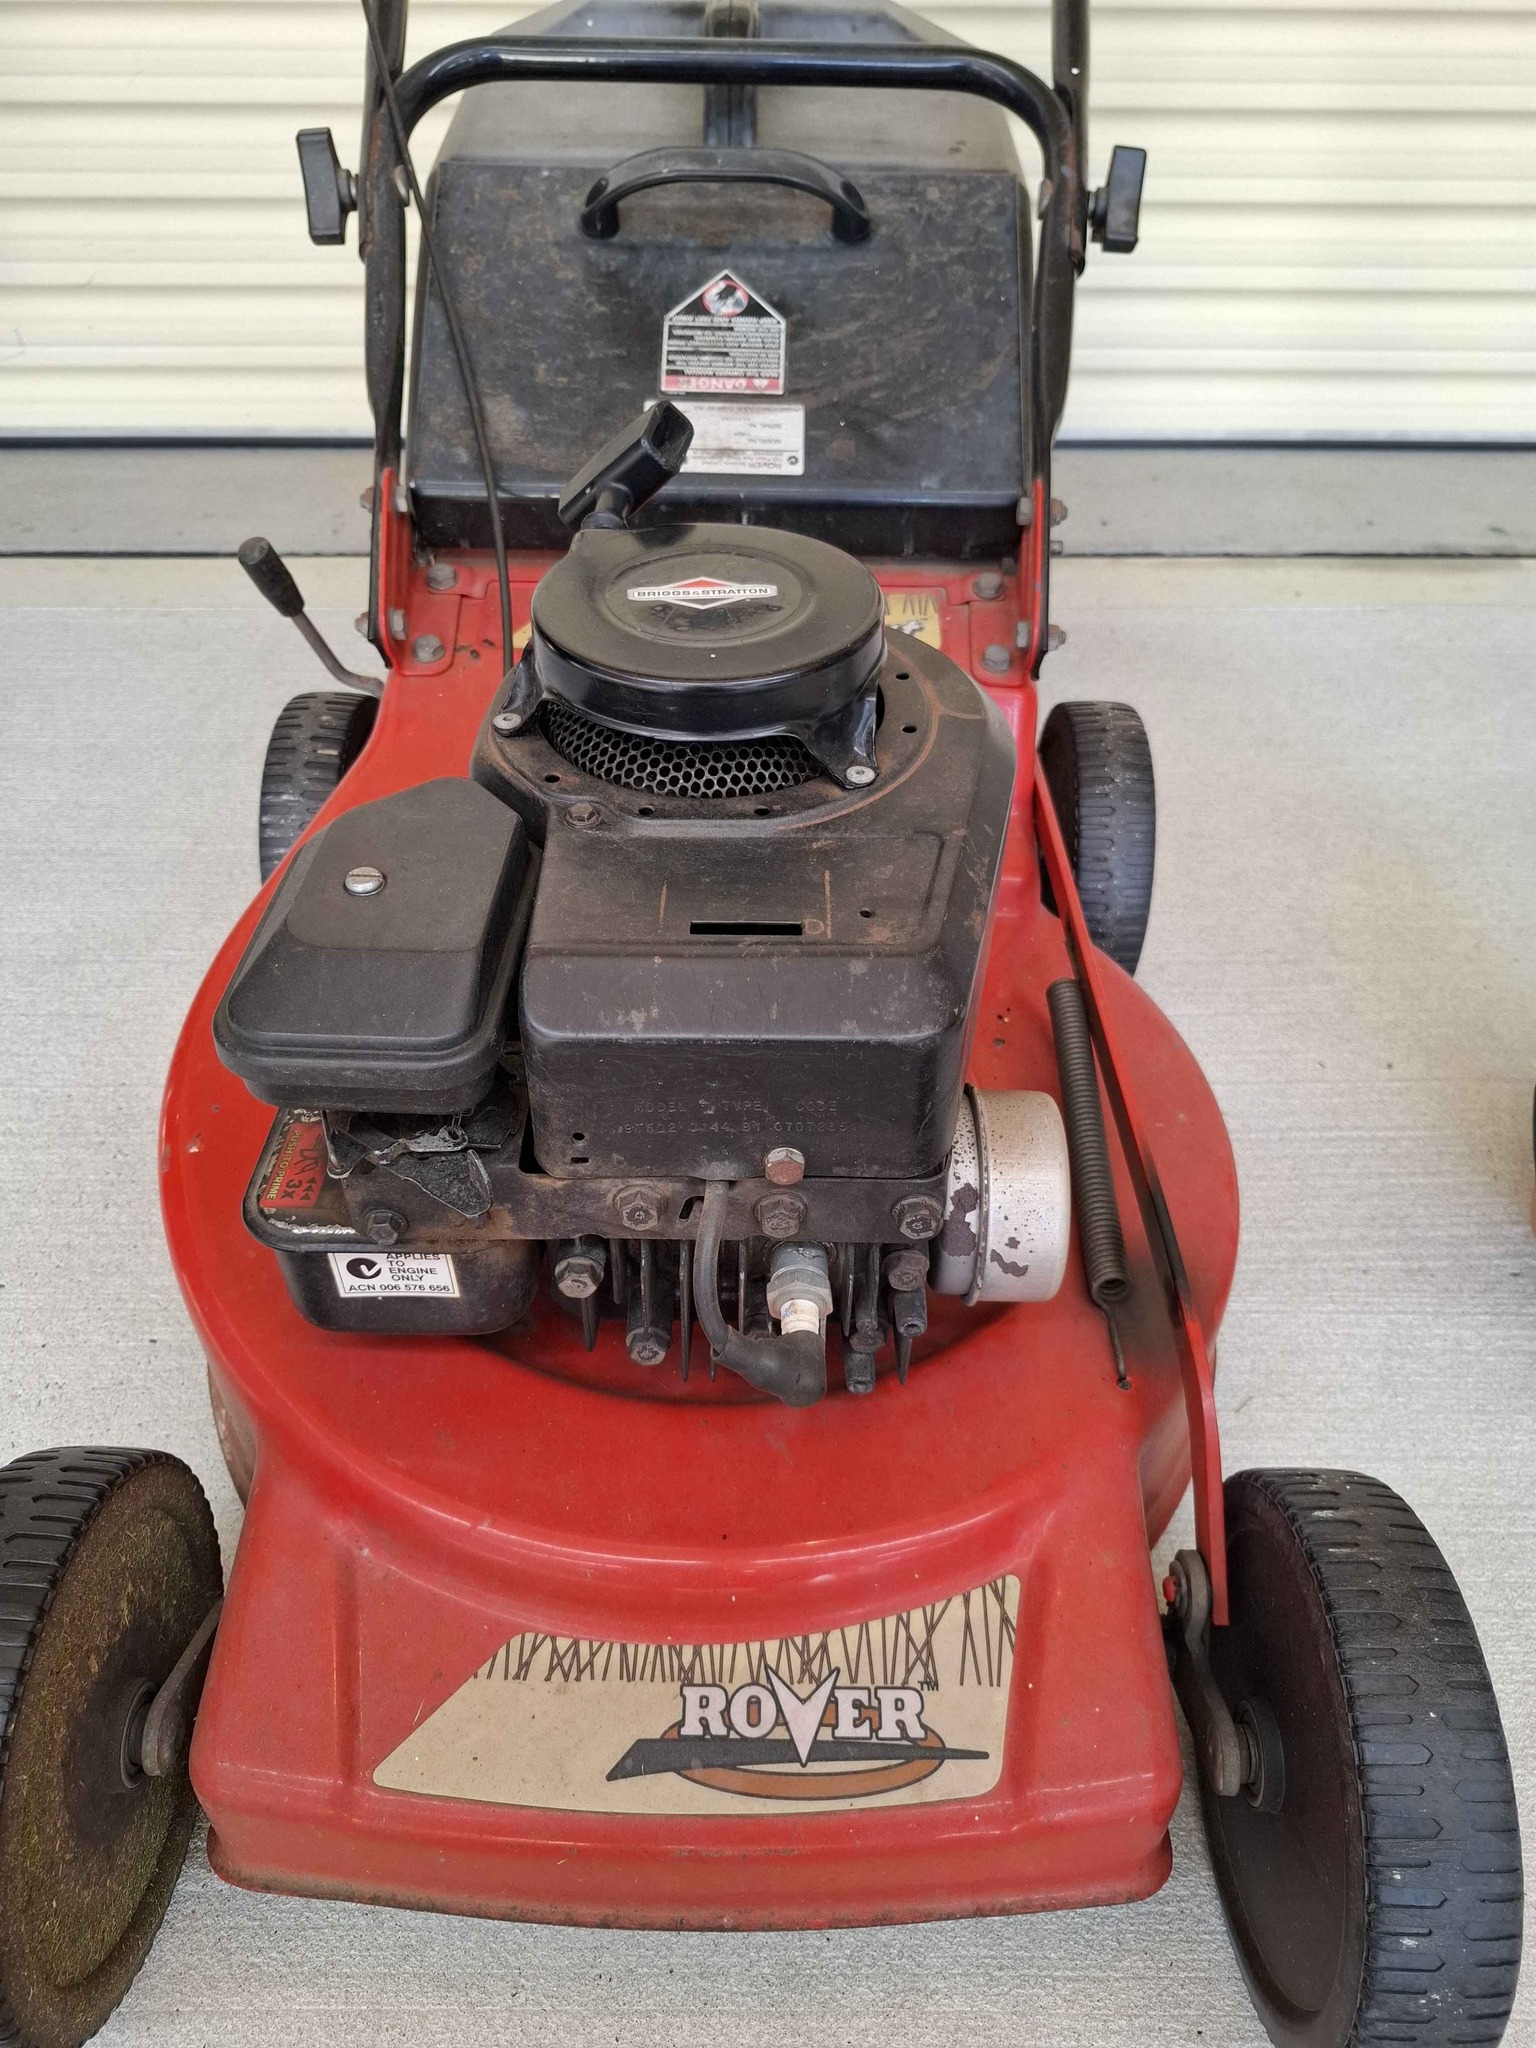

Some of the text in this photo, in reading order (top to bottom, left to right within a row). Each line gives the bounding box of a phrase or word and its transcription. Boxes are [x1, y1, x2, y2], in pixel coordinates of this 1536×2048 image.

[634, 1100, 687, 1113] MODEL
[796, 1100, 838, 1112] CODE
[266, 1130, 302, 1201] PUSH TO PRIME
[389, 1267, 438, 1275] ENGINE
[349, 1283, 376, 1292] ACN
[678, 1664, 928, 1768] ROVER
